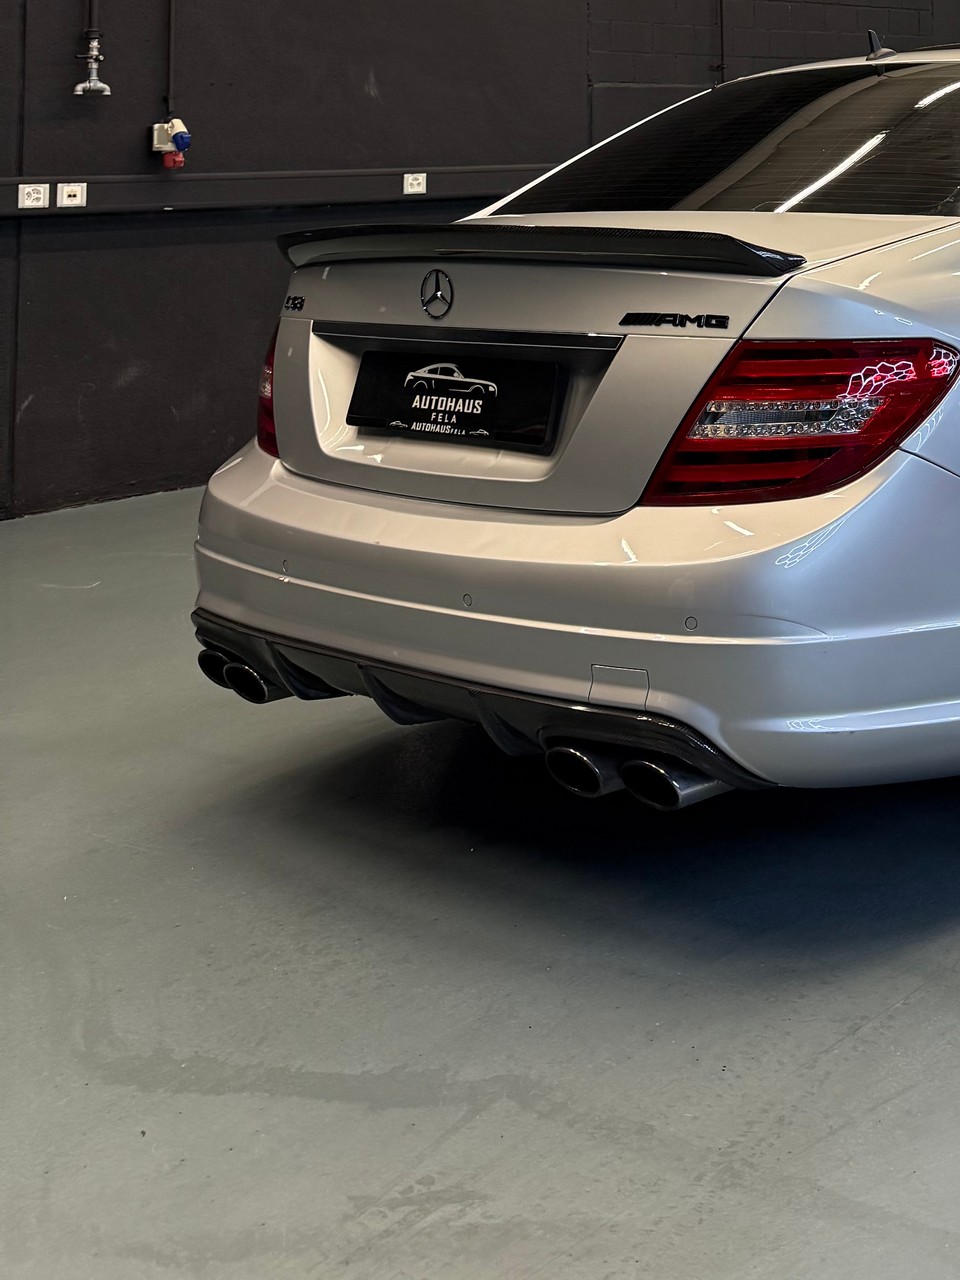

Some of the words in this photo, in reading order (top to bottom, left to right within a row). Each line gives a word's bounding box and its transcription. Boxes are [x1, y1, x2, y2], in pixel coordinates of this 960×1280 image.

[653, 313, 730, 329] AMG
[411, 395, 483, 414] AUTOHAUS
[430, 412, 457, 424] FELA
